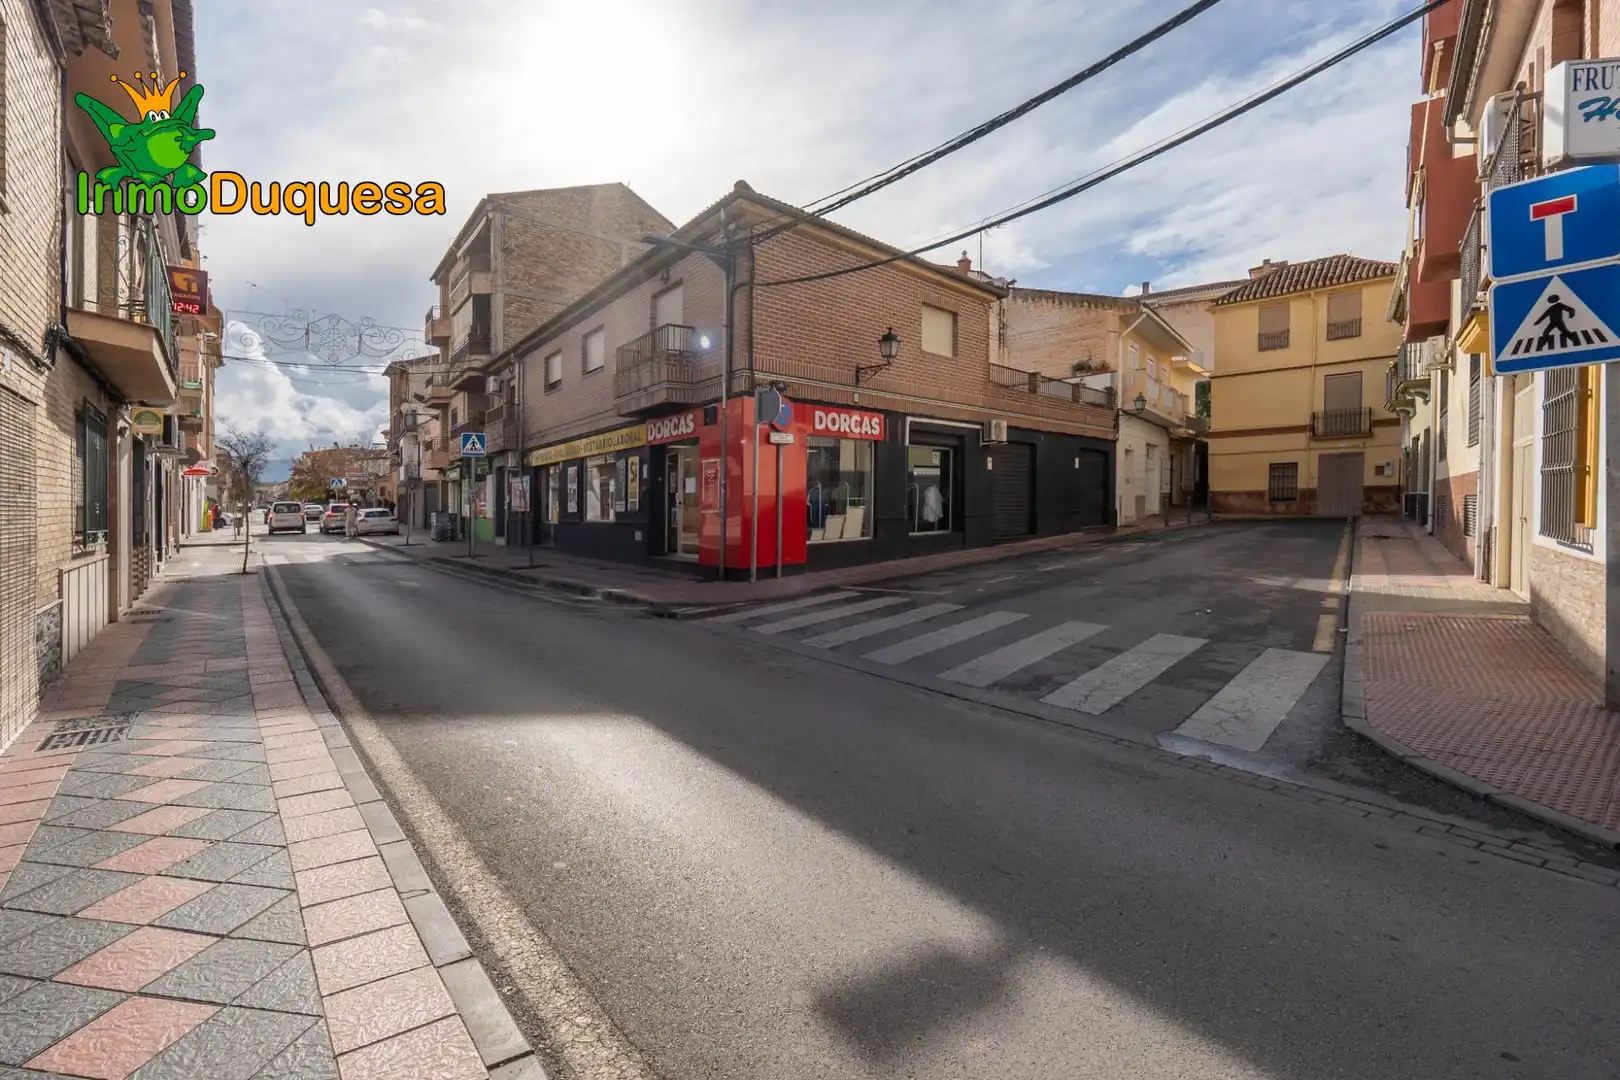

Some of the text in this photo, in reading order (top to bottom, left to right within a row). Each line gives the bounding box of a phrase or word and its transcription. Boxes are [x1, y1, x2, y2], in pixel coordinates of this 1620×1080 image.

[174, 302, 200, 314] 12:42
[647, 413, 695, 442] DORCAS
[814, 410, 880, 436] DORCAS
